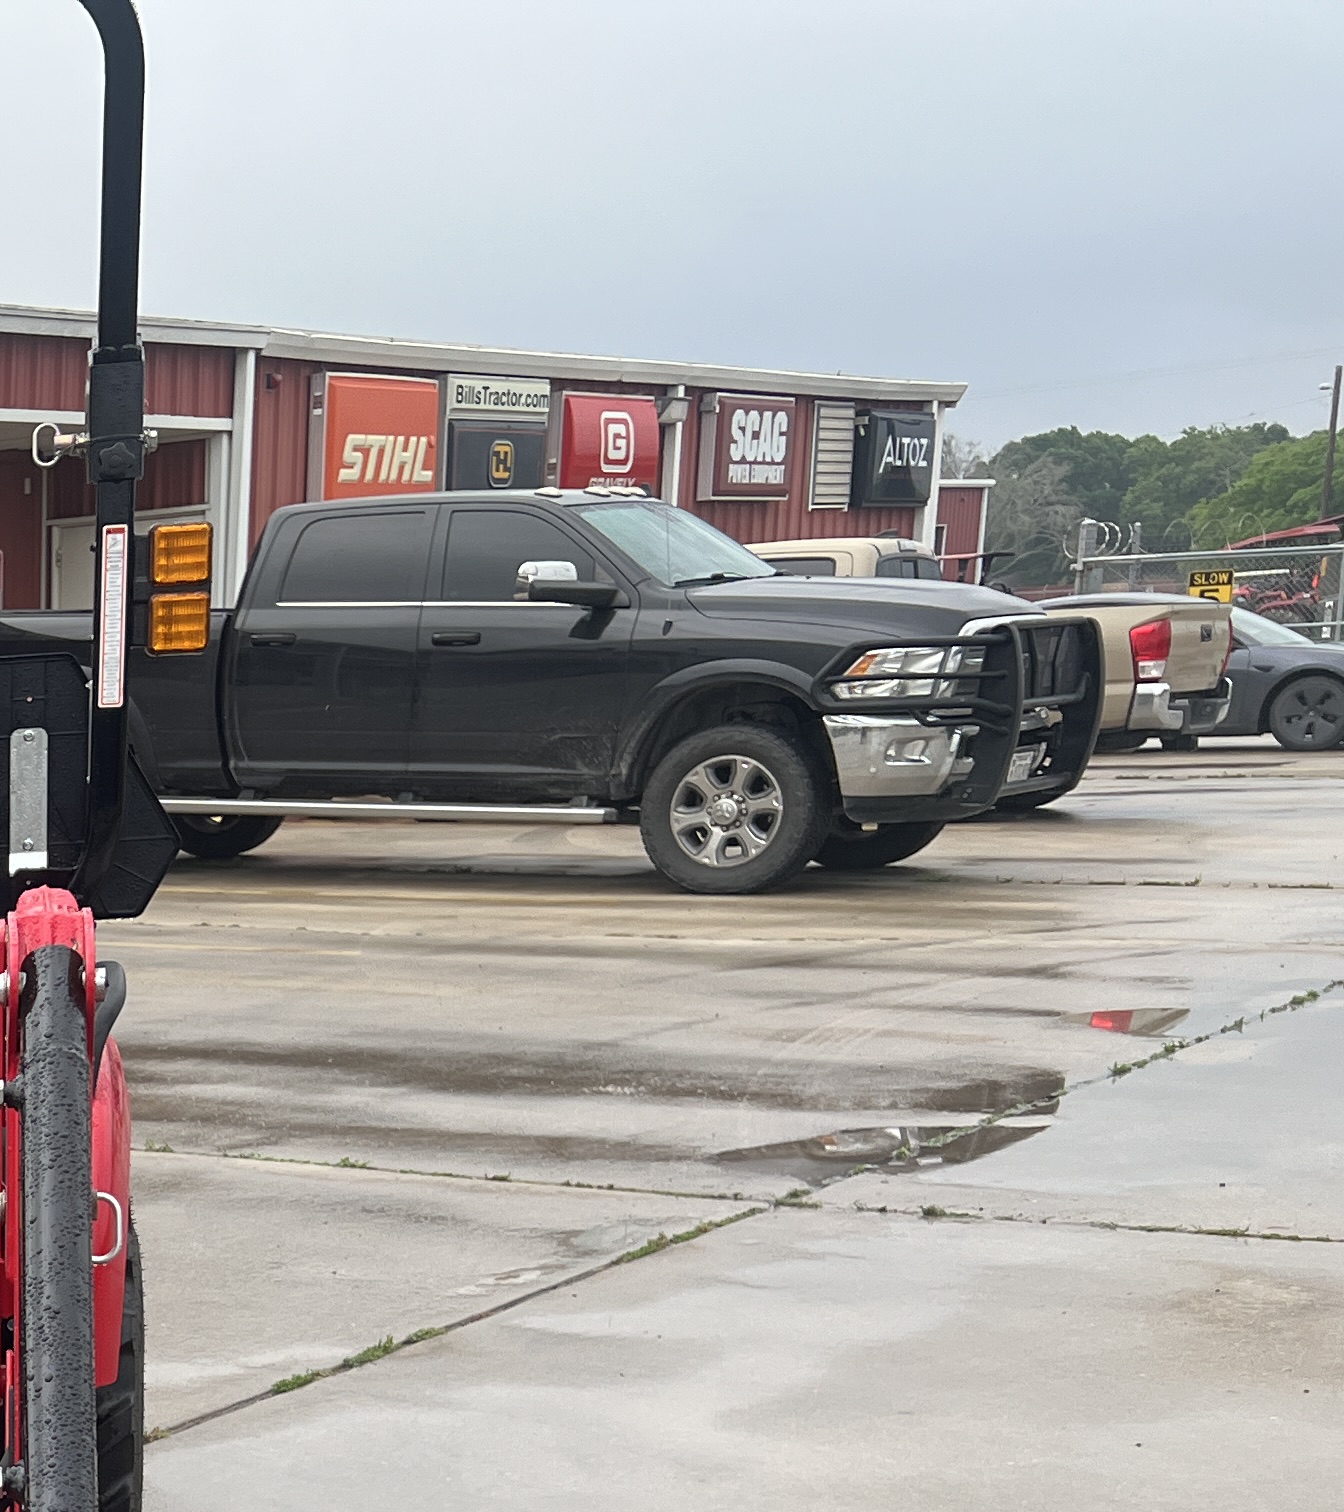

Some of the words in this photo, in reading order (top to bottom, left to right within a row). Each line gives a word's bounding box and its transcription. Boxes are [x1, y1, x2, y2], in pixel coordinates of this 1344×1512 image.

[455, 384, 550, 409] BillsTractor.com
[729, 408, 788, 463] SCAG
[879, 433, 929, 474] ALTOZ
[337, 433, 433, 484] STIHL
[1192, 572, 1230, 586] SLOW
